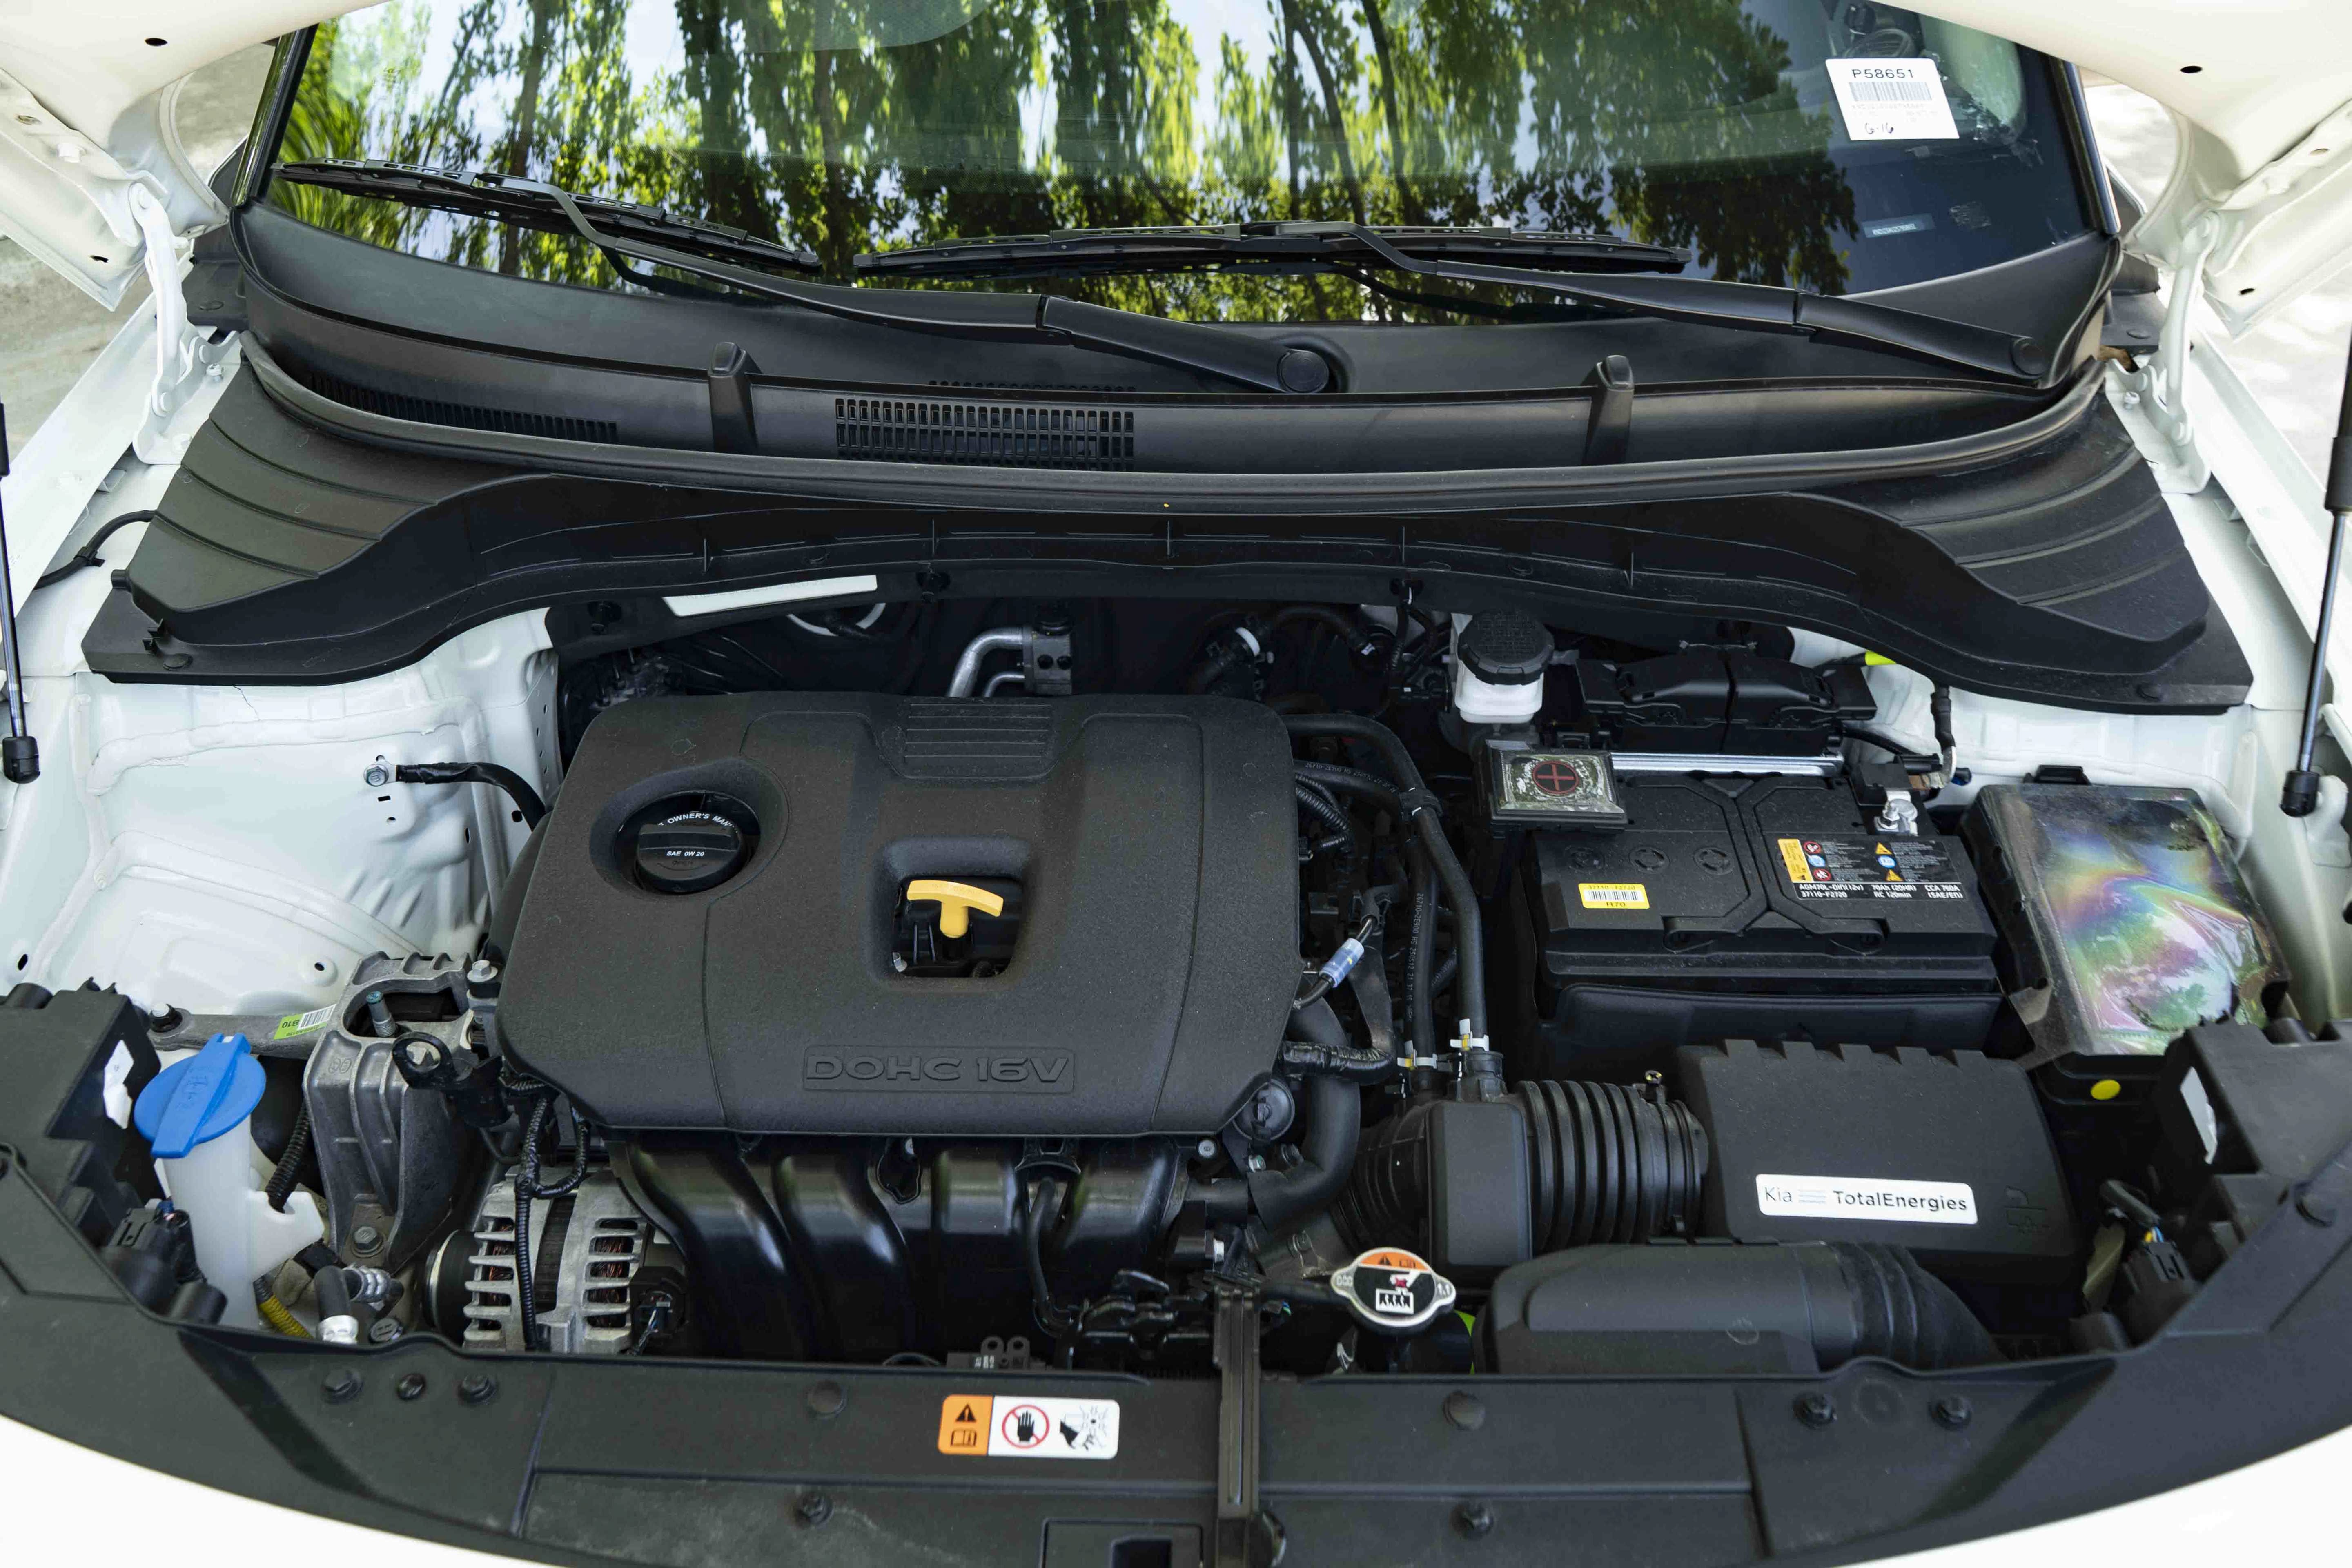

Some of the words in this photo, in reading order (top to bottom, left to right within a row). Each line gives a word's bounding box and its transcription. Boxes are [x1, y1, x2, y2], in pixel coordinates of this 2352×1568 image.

[1852, 69, 1914, 78] P58651
[667, 813, 710, 824] OWNER'S
[282, 1020, 299, 1028] B10
[806, 1056, 962, 1081] DOHC
[976, 1057, 1068, 1083] 16V
[1764, 1186, 1793, 1204] Kia
[1833, 1190, 1967, 1212] TotalEnergies
